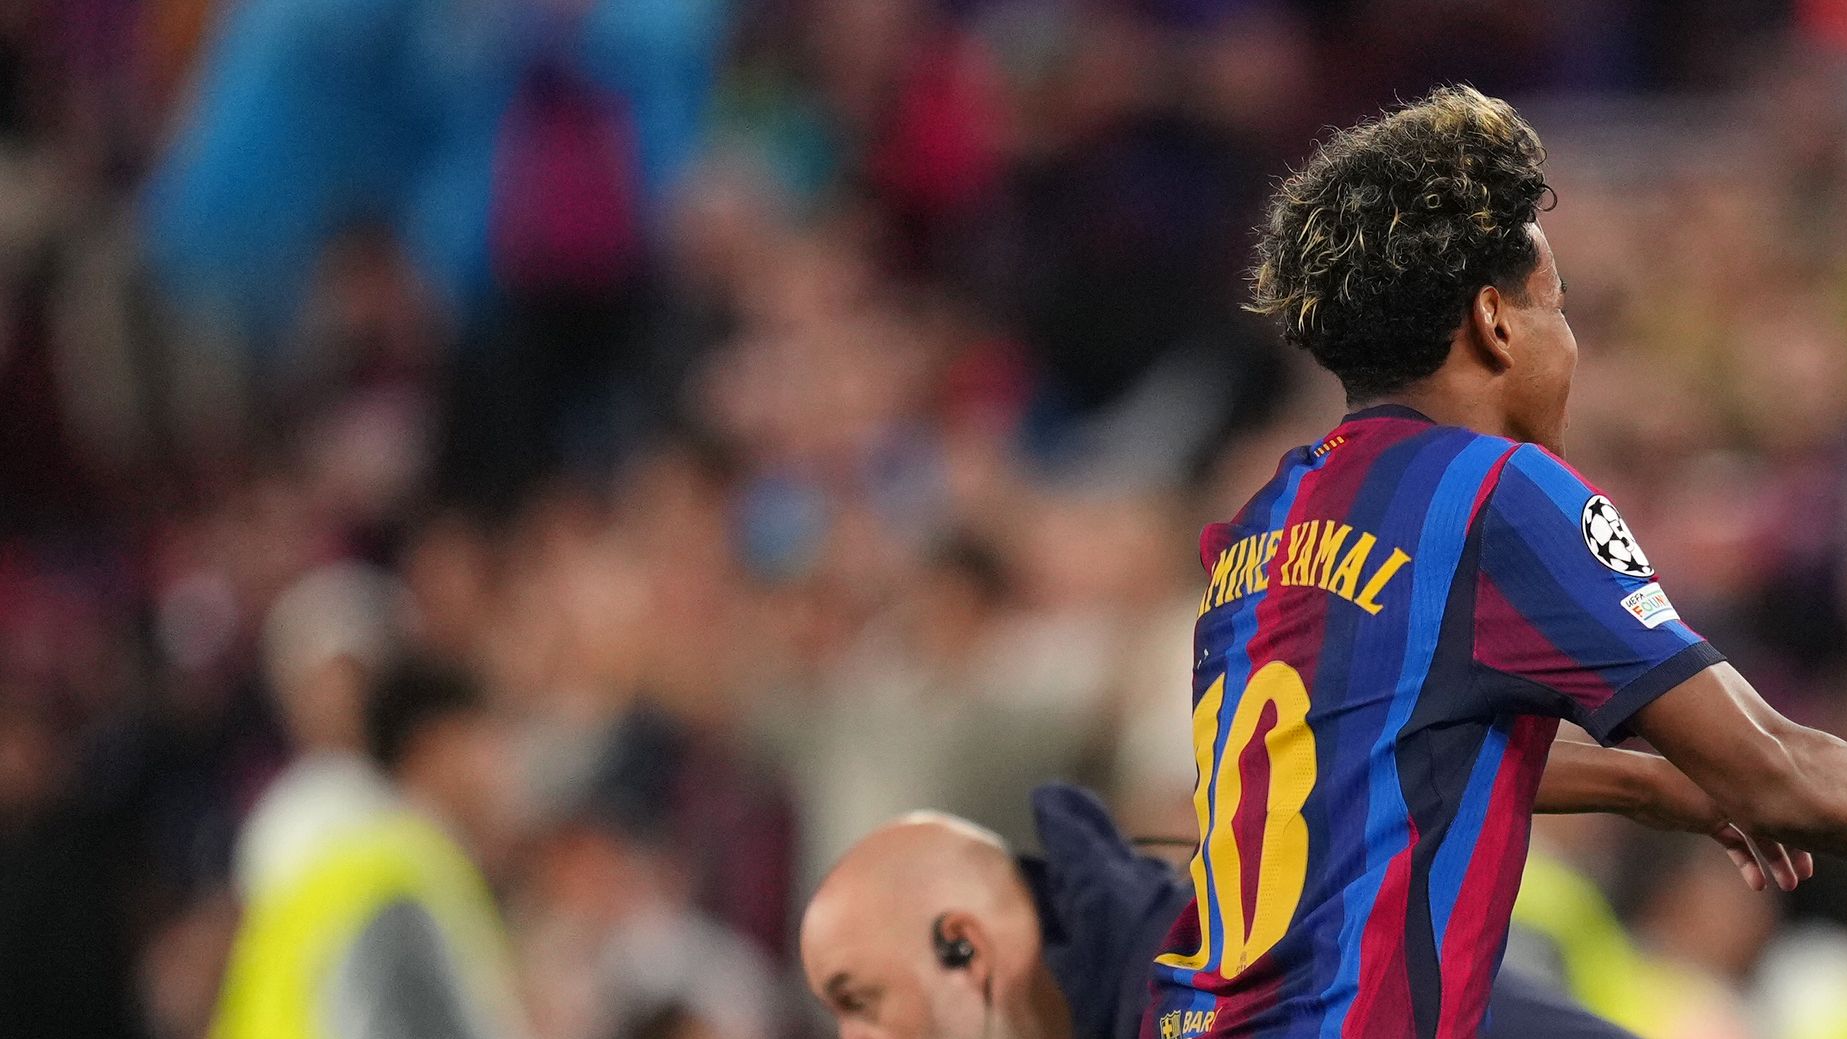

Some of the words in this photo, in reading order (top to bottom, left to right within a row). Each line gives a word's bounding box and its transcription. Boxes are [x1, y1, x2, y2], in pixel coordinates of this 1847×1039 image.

[1280, 519, 1412, 616] YAMAL
[1625, 592, 1645, 608] UEFA
[1632, 594, 1668, 618] FOUN
[1153, 660, 1317, 980] 10
[1182, 1007, 1222, 1034] BAR
